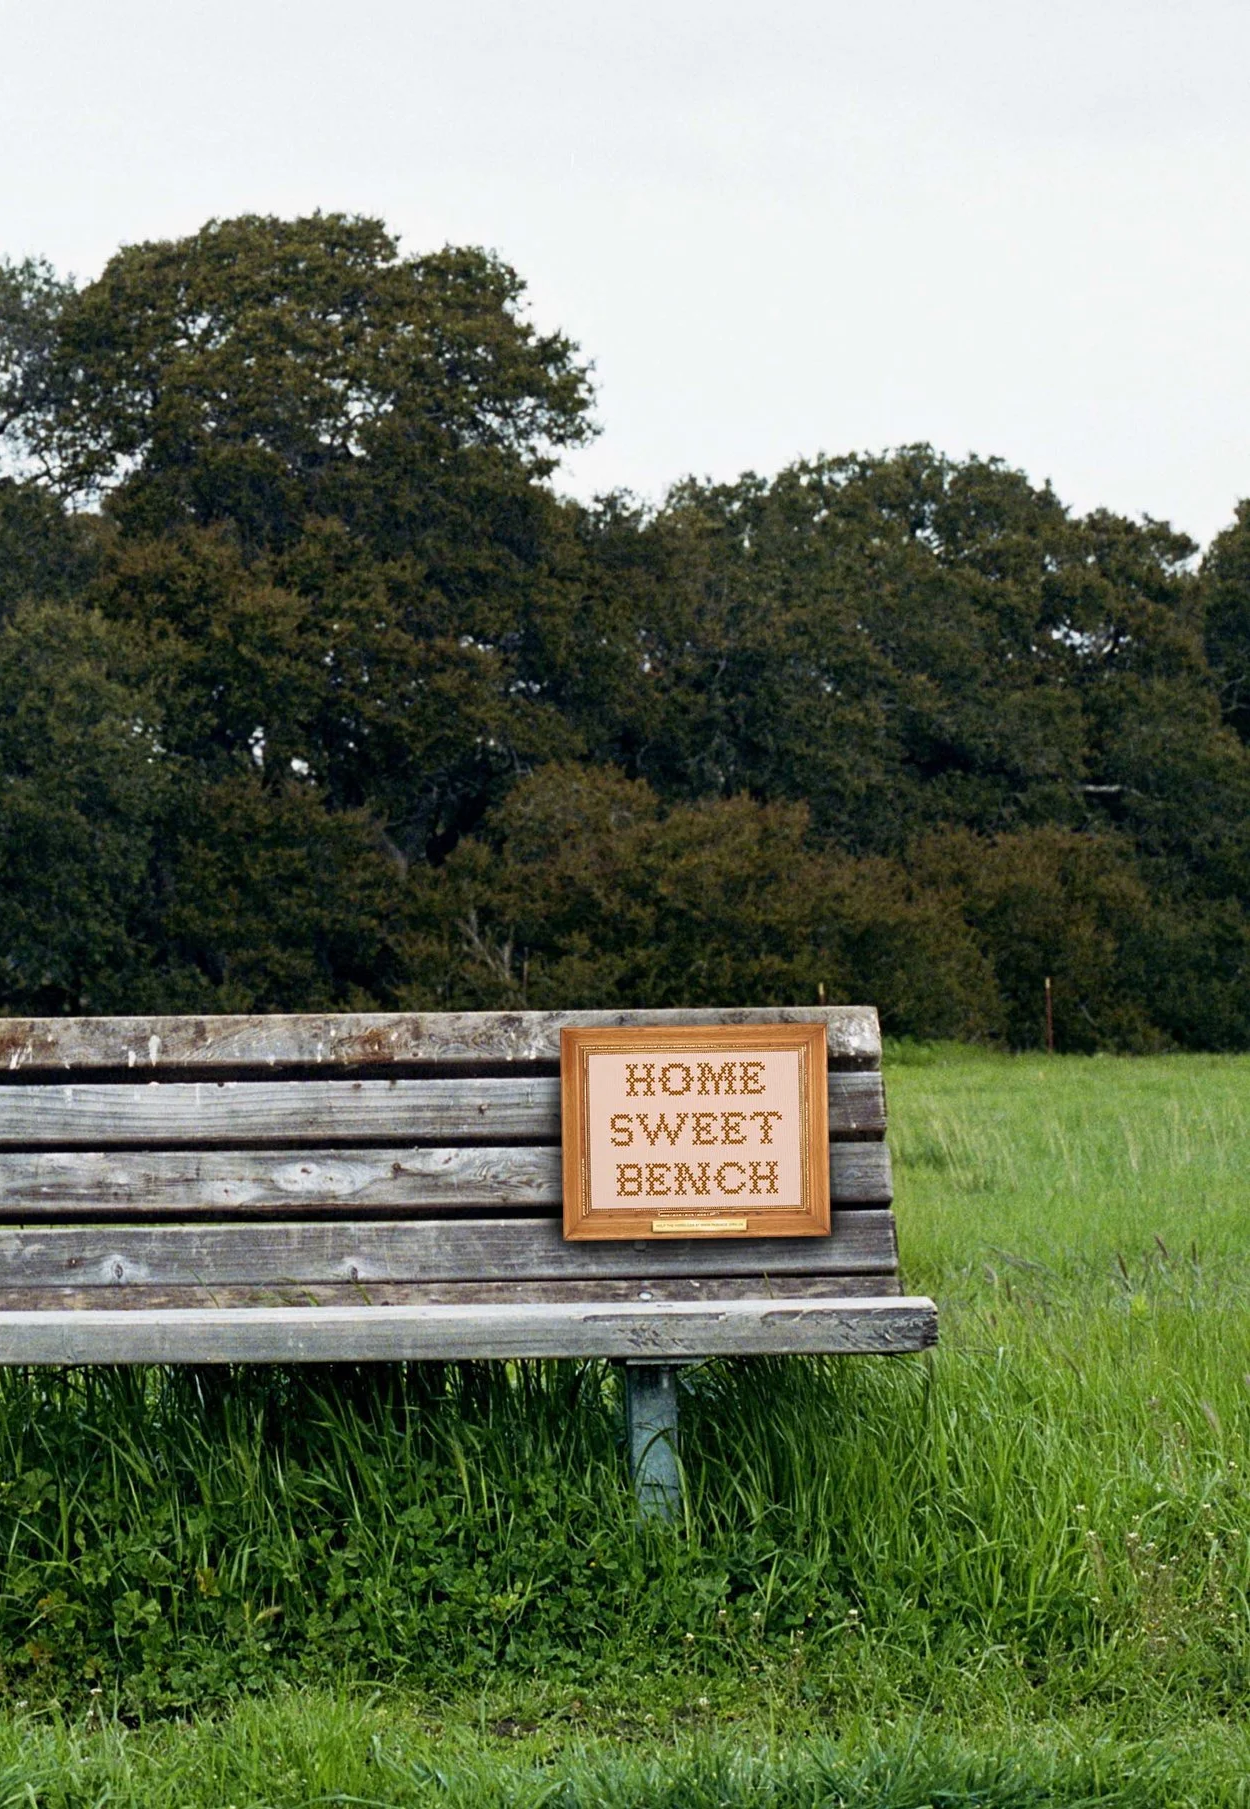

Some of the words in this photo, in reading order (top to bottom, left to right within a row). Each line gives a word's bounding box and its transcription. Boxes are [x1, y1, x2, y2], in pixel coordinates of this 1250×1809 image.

[625, 1061, 766, 1097] HOME
[610, 1111, 783, 1147] SWEET
[616, 1161, 779, 1197] BENCH
